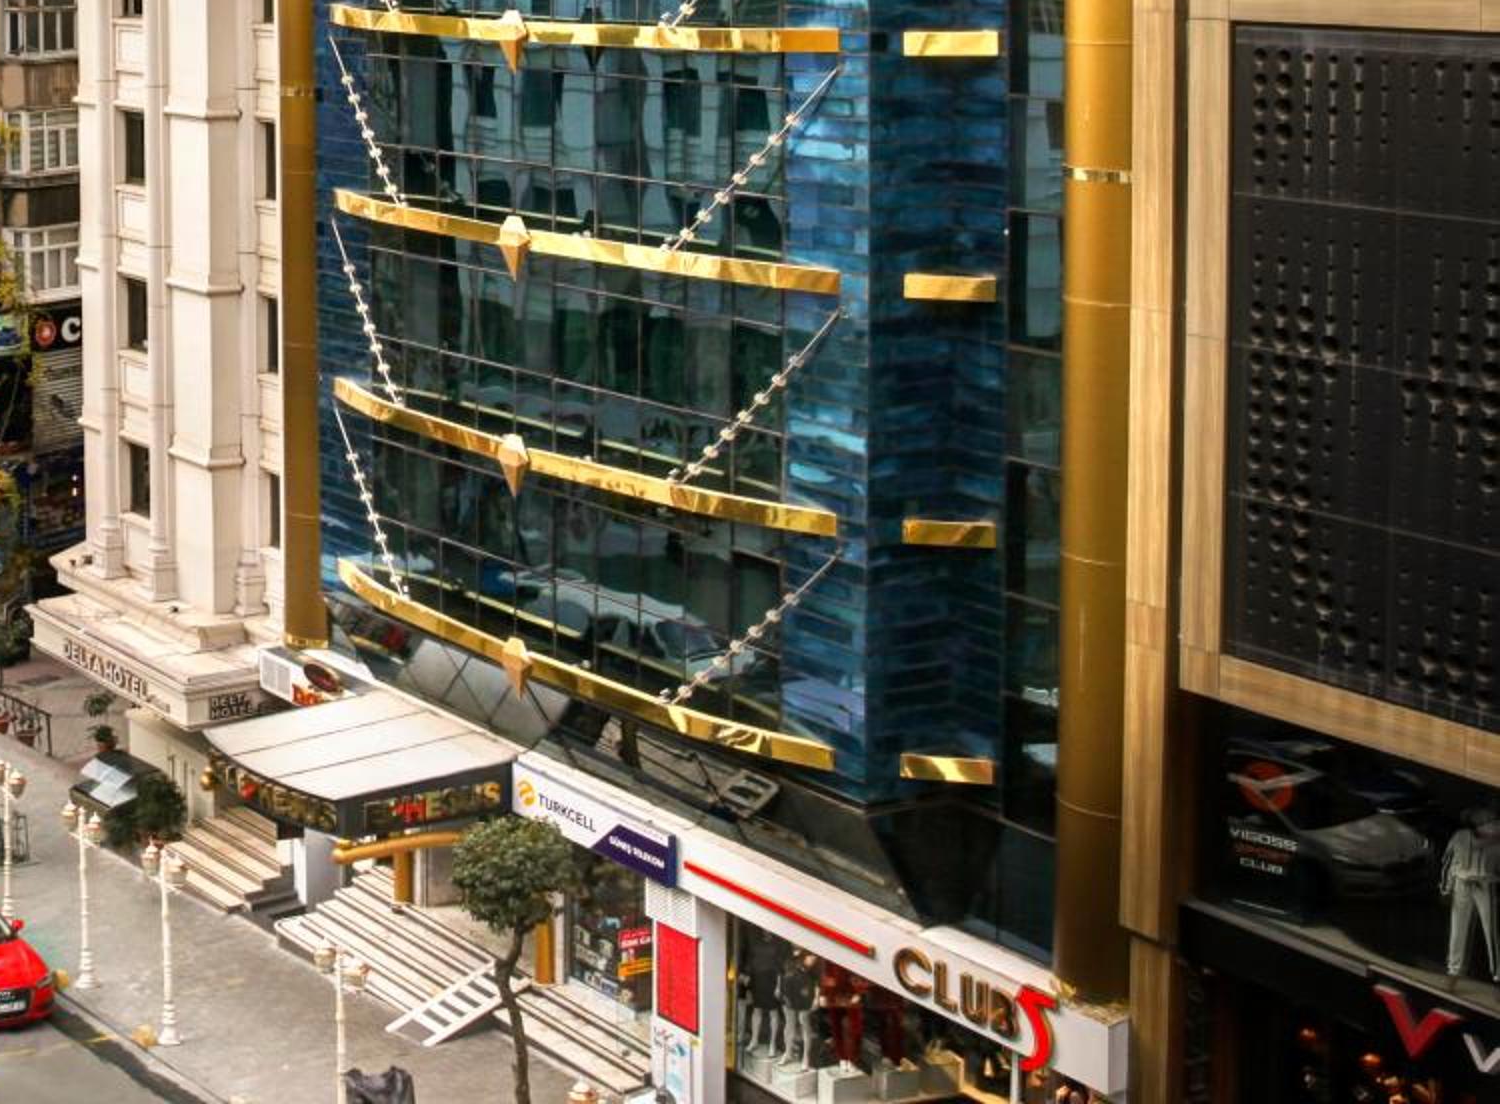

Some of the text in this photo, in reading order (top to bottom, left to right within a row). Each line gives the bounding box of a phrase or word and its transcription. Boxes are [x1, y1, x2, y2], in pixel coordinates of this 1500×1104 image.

[104, 663, 148, 697] HOTEL
[538, 793, 597, 833] TURKCELL
[1239, 856, 1284, 875] CLUB
